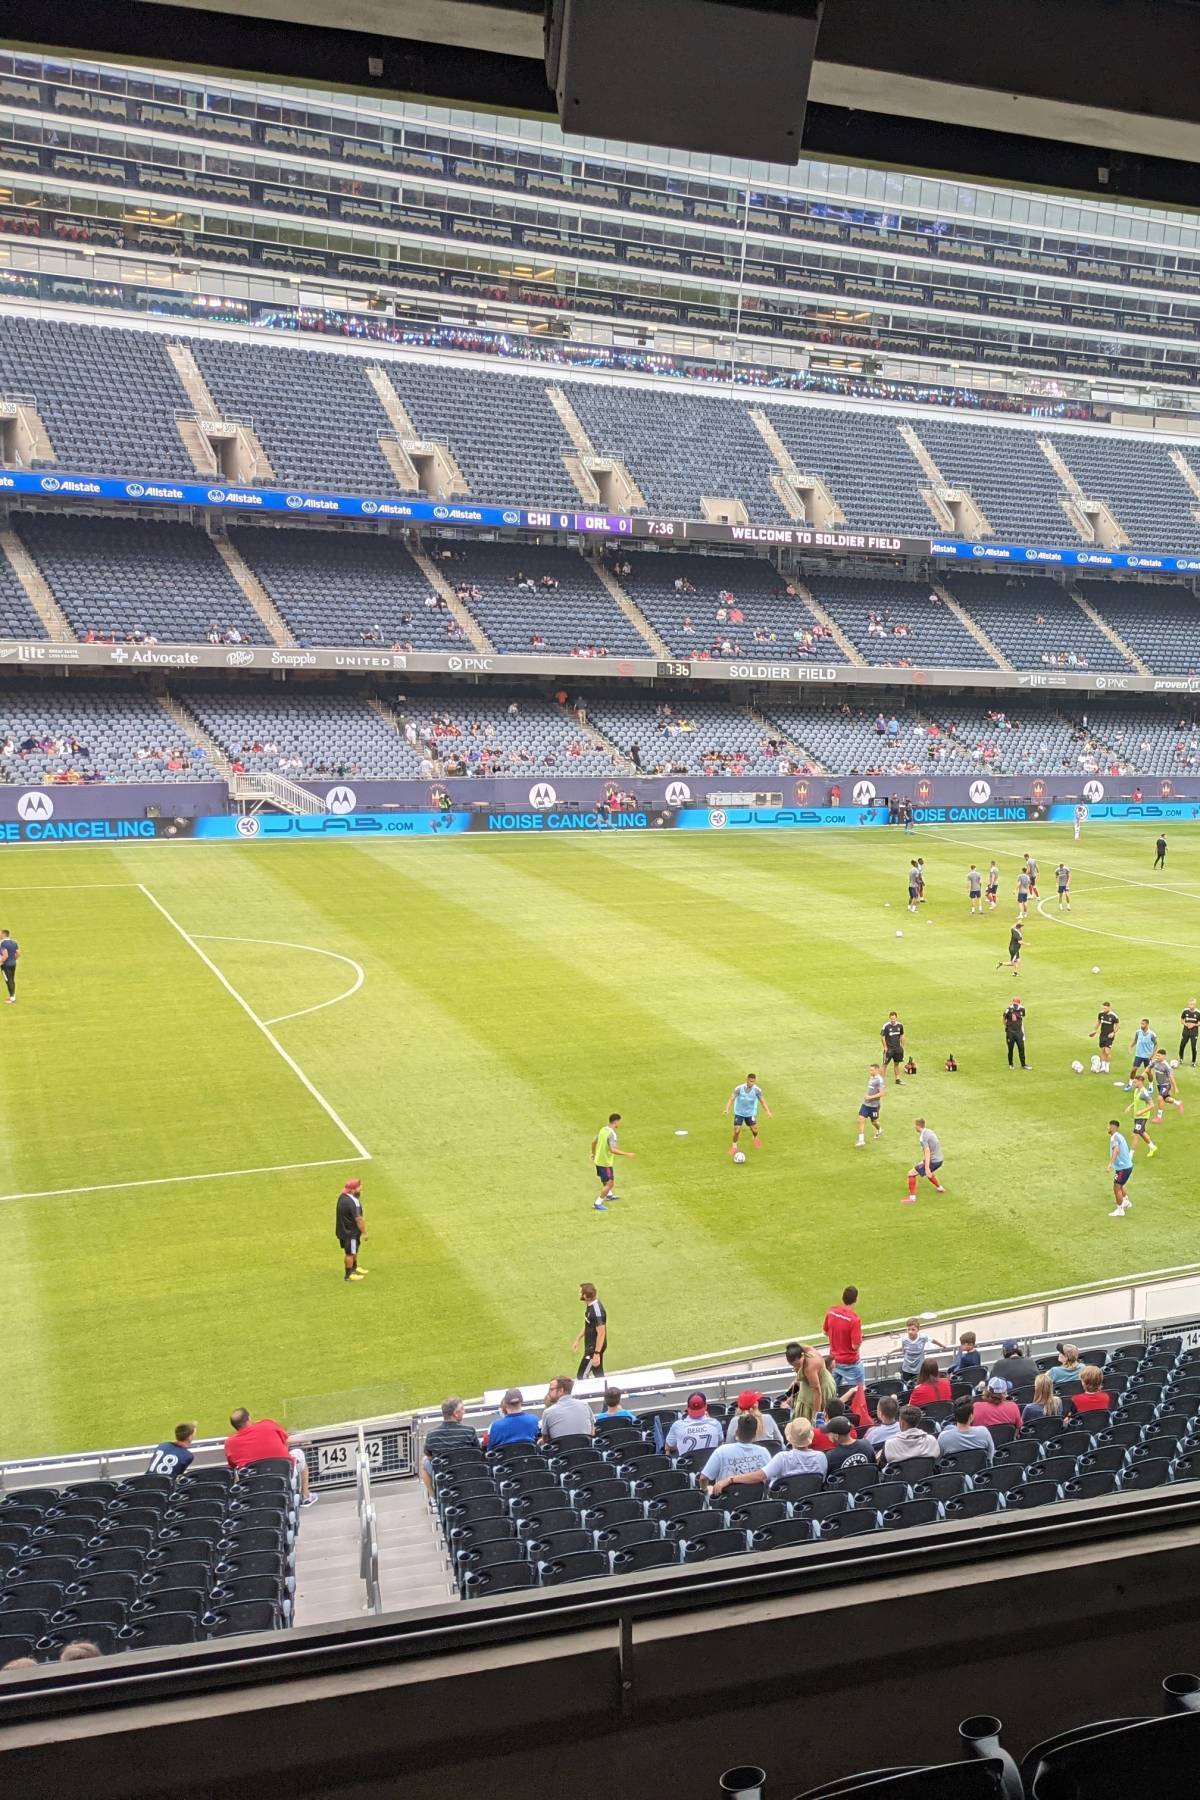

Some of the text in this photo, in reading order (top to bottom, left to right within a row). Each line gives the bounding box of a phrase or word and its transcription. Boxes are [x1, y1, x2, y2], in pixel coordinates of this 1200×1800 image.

[60, 480, 100, 494] Allstate
[144, 486, 184, 500] Allstate
[224, 492, 263, 505] Allstate
[303, 498, 339, 510] Allstate
[378, 504, 412, 516] Allstate
[449, 510, 482, 520] Allstate
[528, 512, 550, 525] CHI
[560, 514, 568, 527] 0
[586, 517, 610, 530] ORL
[619, 518, 626, 532] 0
[648, 522, 674, 535] 7:36
[732, 527, 901, 550] WELCOME TO SOLDIER FIELD
[932, 544, 957, 554] Allstate
[984, 548, 1010, 558] Allstate
[1037, 552, 1062, 561] Allstate
[1088, 555, 1112, 564] Allstate
[1138, 558, 1162, 568] Allstate
[16, 646, 46, 662] Lite
[132, 650, 199, 664] Advocate
[272, 652, 316, 667] Snapple
[336, 656, 390, 666] UNITED
[464, 658, 494, 670] PNC
[730, 666, 836, 680] SOLDIER FIELD
[1030, 676, 1047, 686] Lite
[1107, 678, 1128, 688] PNC
[1154, 680, 1188, 690] proven
[730, 812, 846, 824] JLAB.COM
[911, 808, 1026, 822] OISE CANCELING
[1091, 806, 1182, 818] JLAB.COM
[264, 818, 414, 833] JLAB.COM
[488, 814, 543, 829] NOISE
[26, 820, 156, 839] CANCELING
[682, 1434, 712, 1450] 27
[148, 1450, 178, 1475] 18
[321, 1448, 348, 1465] 143
